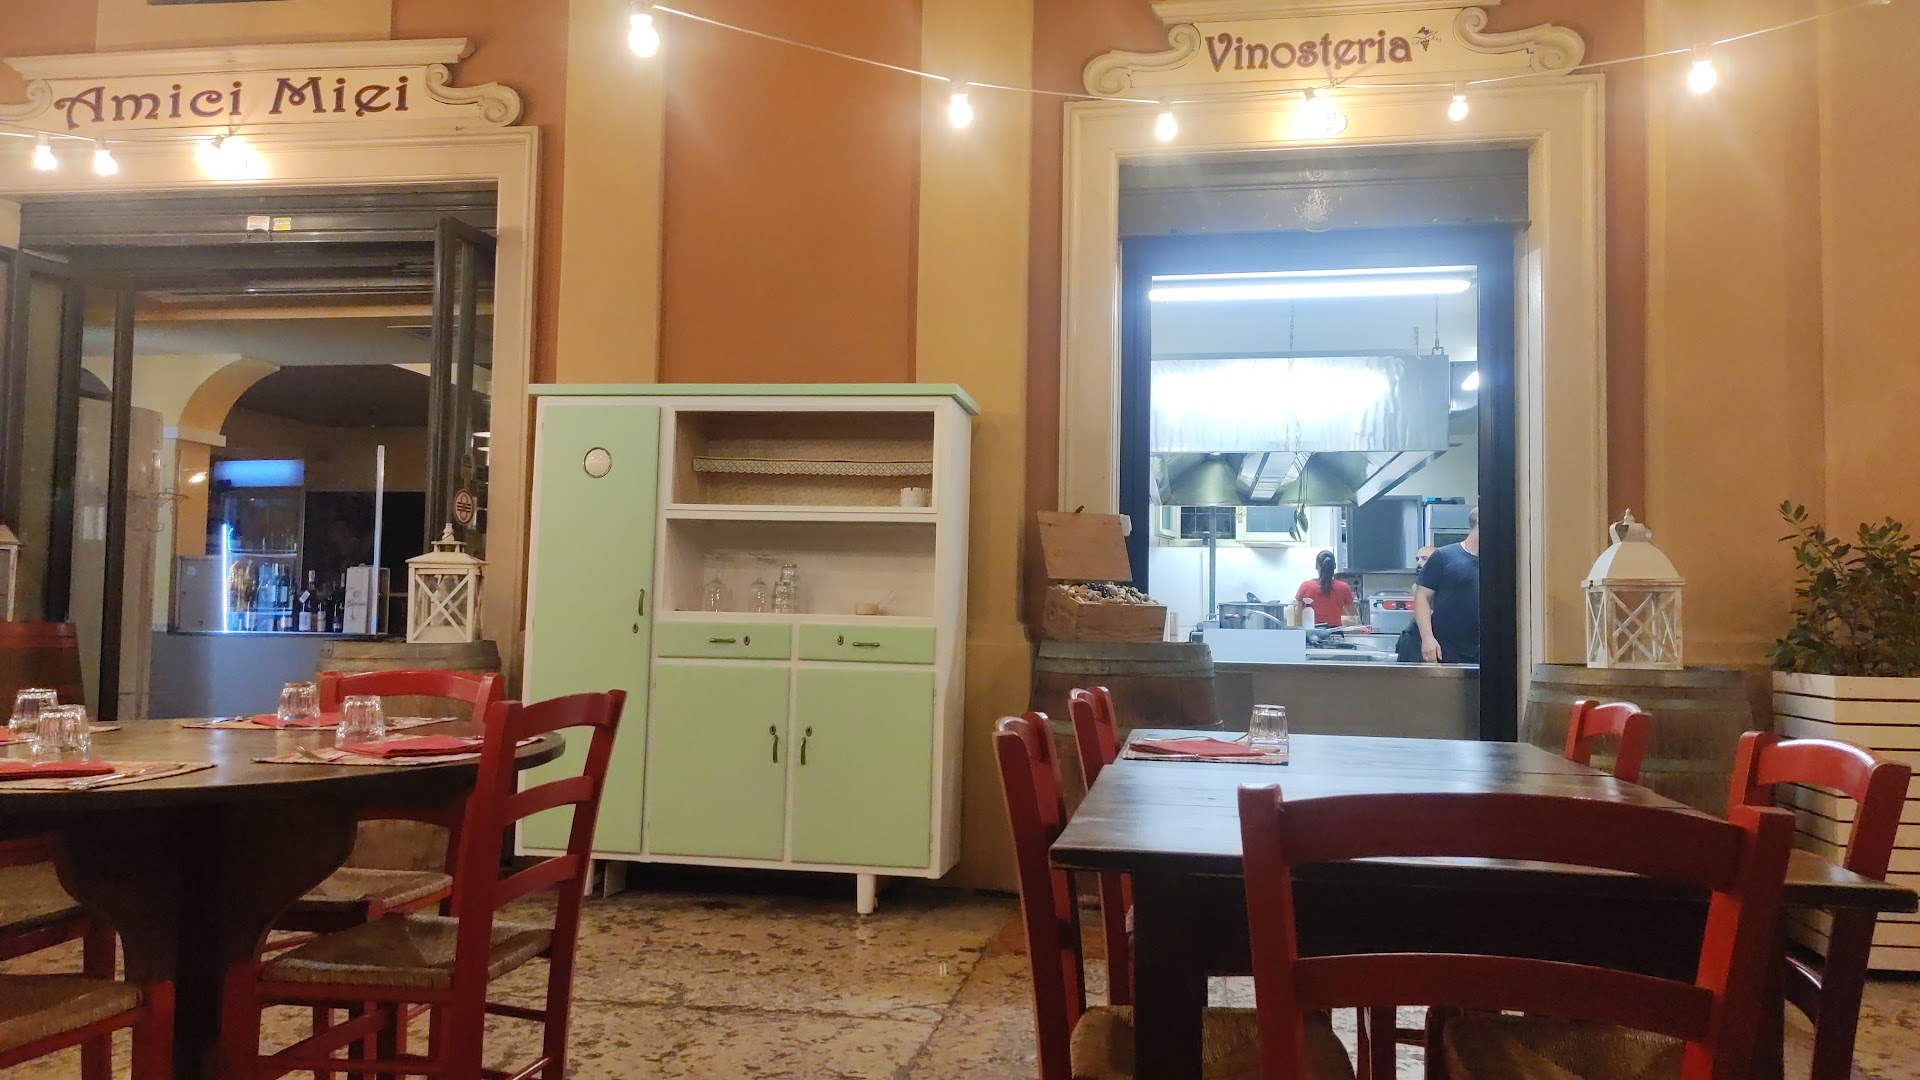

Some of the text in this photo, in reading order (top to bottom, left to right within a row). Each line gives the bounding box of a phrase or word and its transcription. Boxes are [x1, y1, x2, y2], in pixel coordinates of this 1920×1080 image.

[1204, 29, 1413, 73] Vinosteria
[53, 75, 409, 131] Amici Miei
